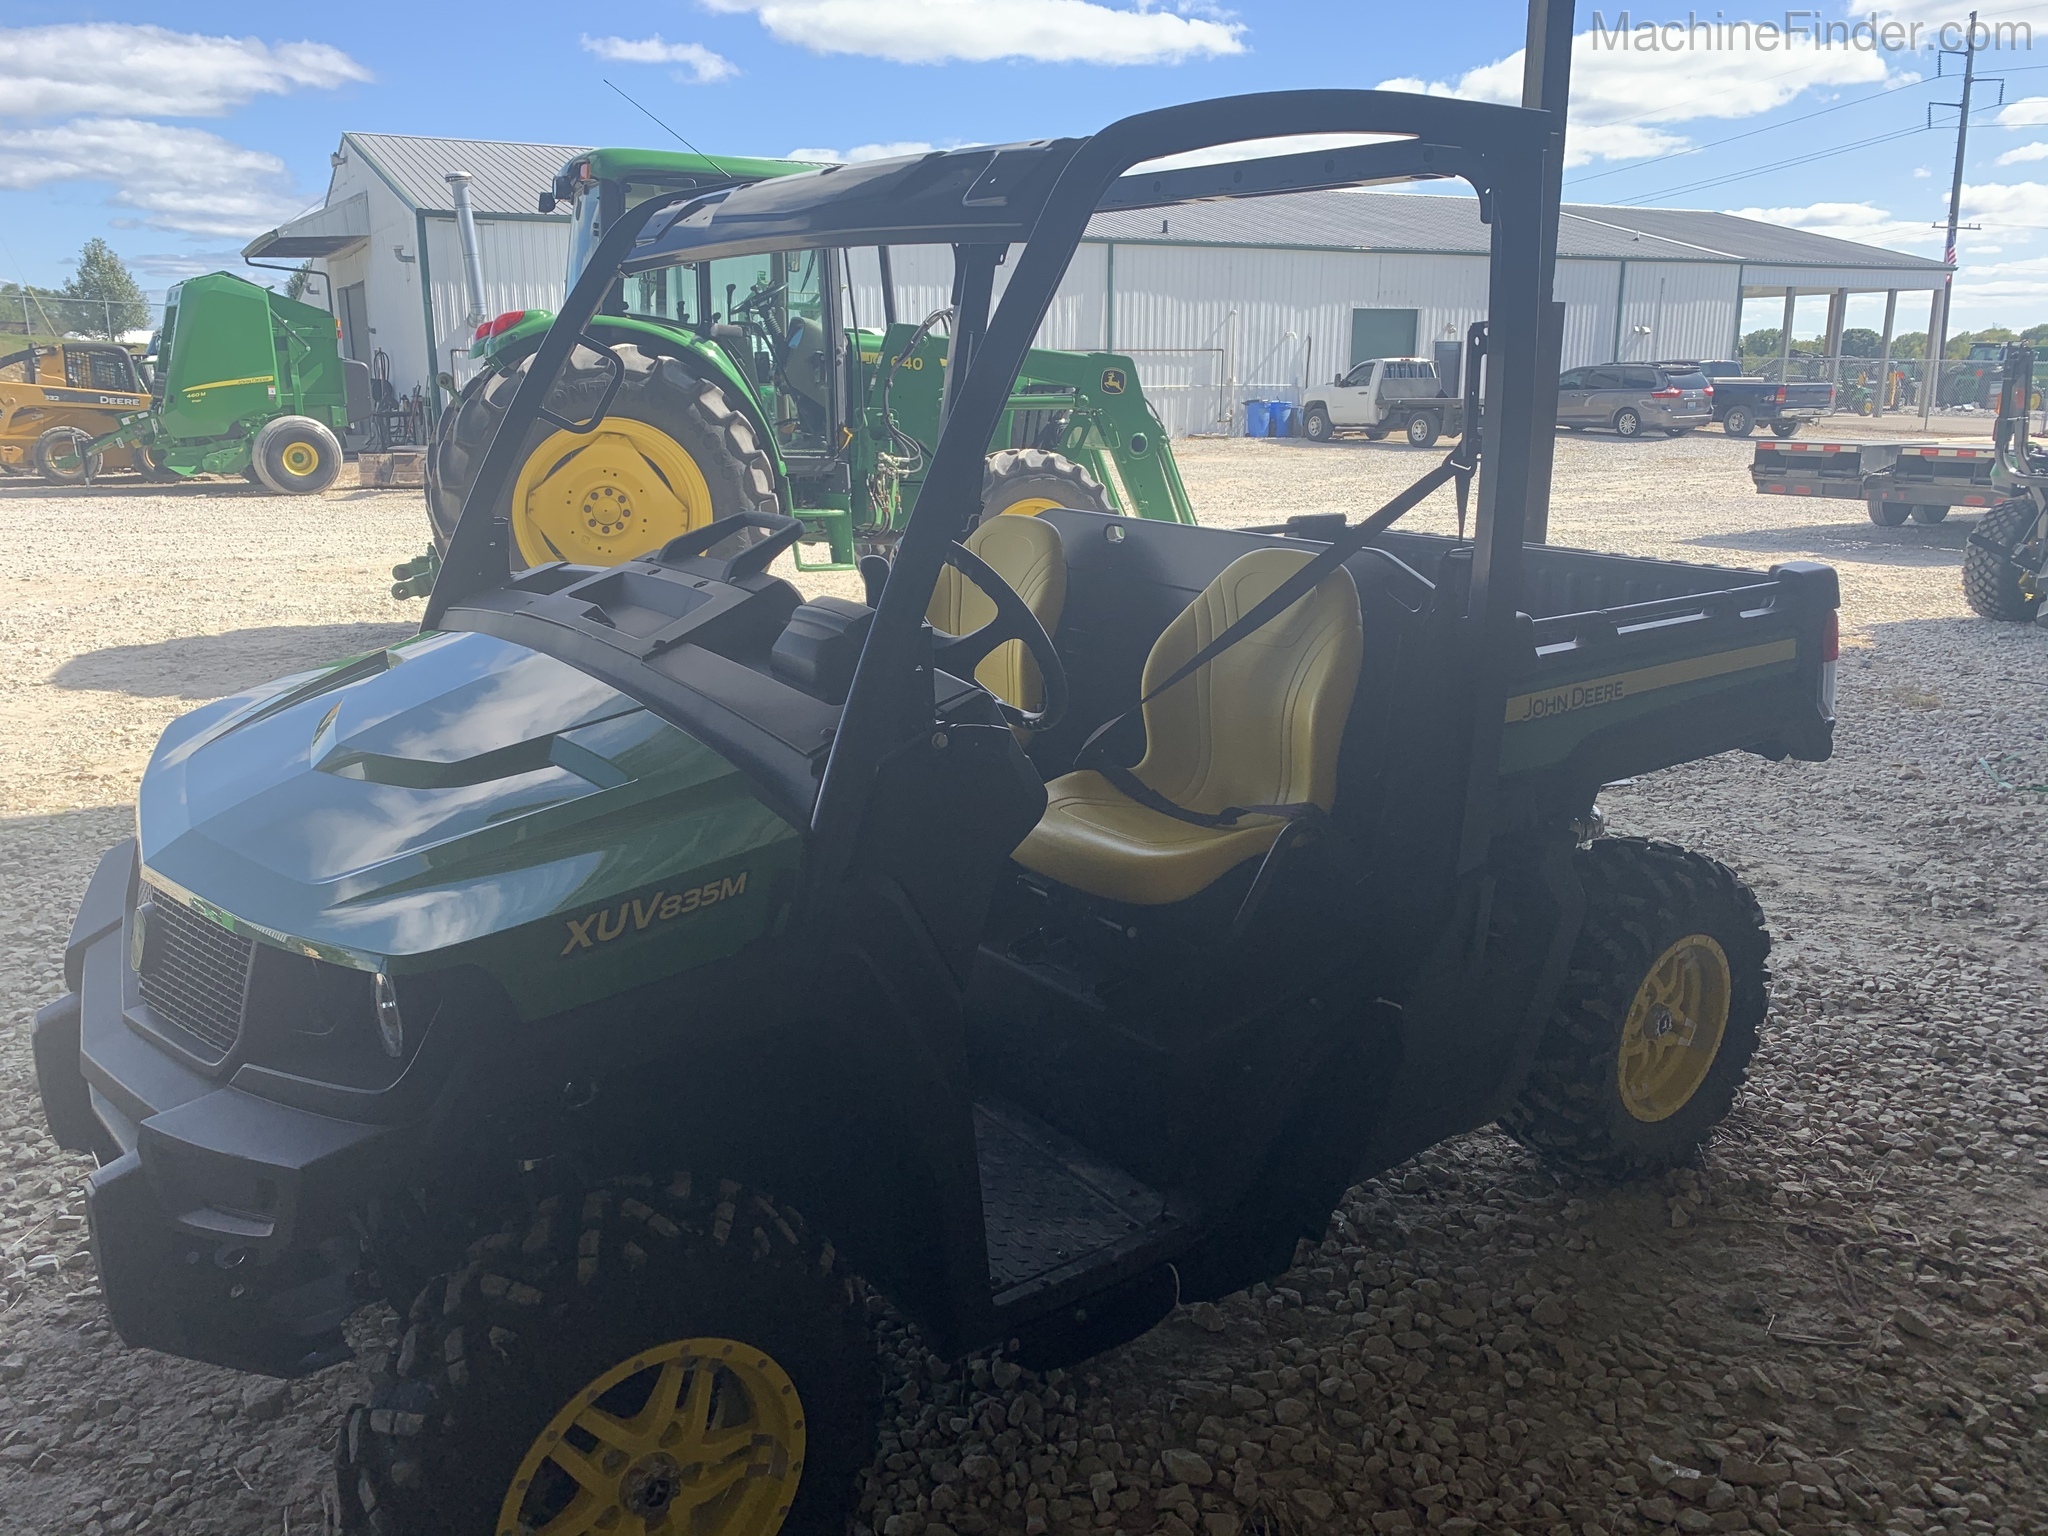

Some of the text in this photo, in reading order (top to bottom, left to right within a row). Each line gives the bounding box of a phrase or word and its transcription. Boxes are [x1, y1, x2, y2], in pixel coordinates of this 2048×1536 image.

[99, 395, 140, 406] DEERE
[1523, 682, 1624, 720] JOHN DEERE
[560, 871, 748, 957] XUV835M
